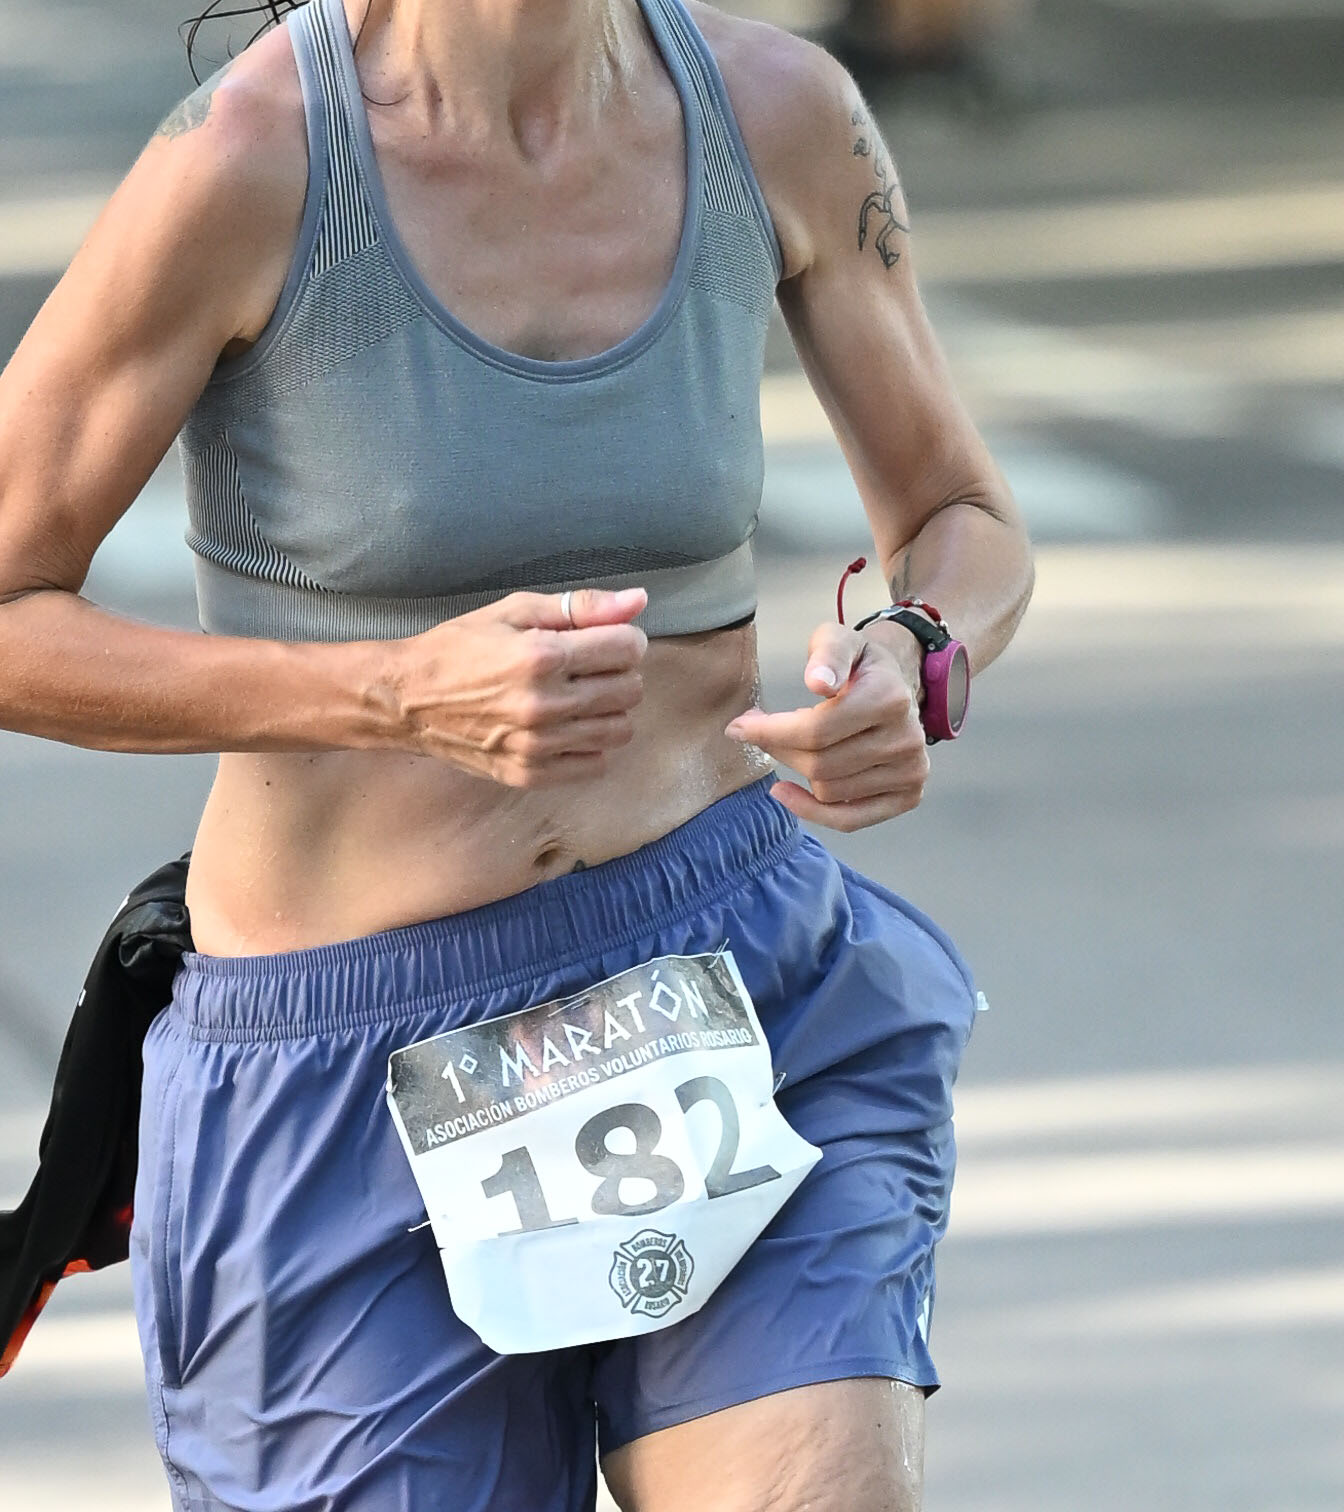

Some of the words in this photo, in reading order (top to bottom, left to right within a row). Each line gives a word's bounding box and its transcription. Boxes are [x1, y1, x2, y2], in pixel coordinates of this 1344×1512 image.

[498, 969, 712, 1087] MARATÓN
[425, 1099, 514, 1148] ASOCIACIÓN
[514, 1067, 600, 1112] BOMBEROS
[600, 1031, 699, 1077] VOLUNTARIOS
[701, 1028, 753, 1048] ROSARIO
[480, 1075, 782, 1237] 182
[637, 1258, 669, 1288] 27
